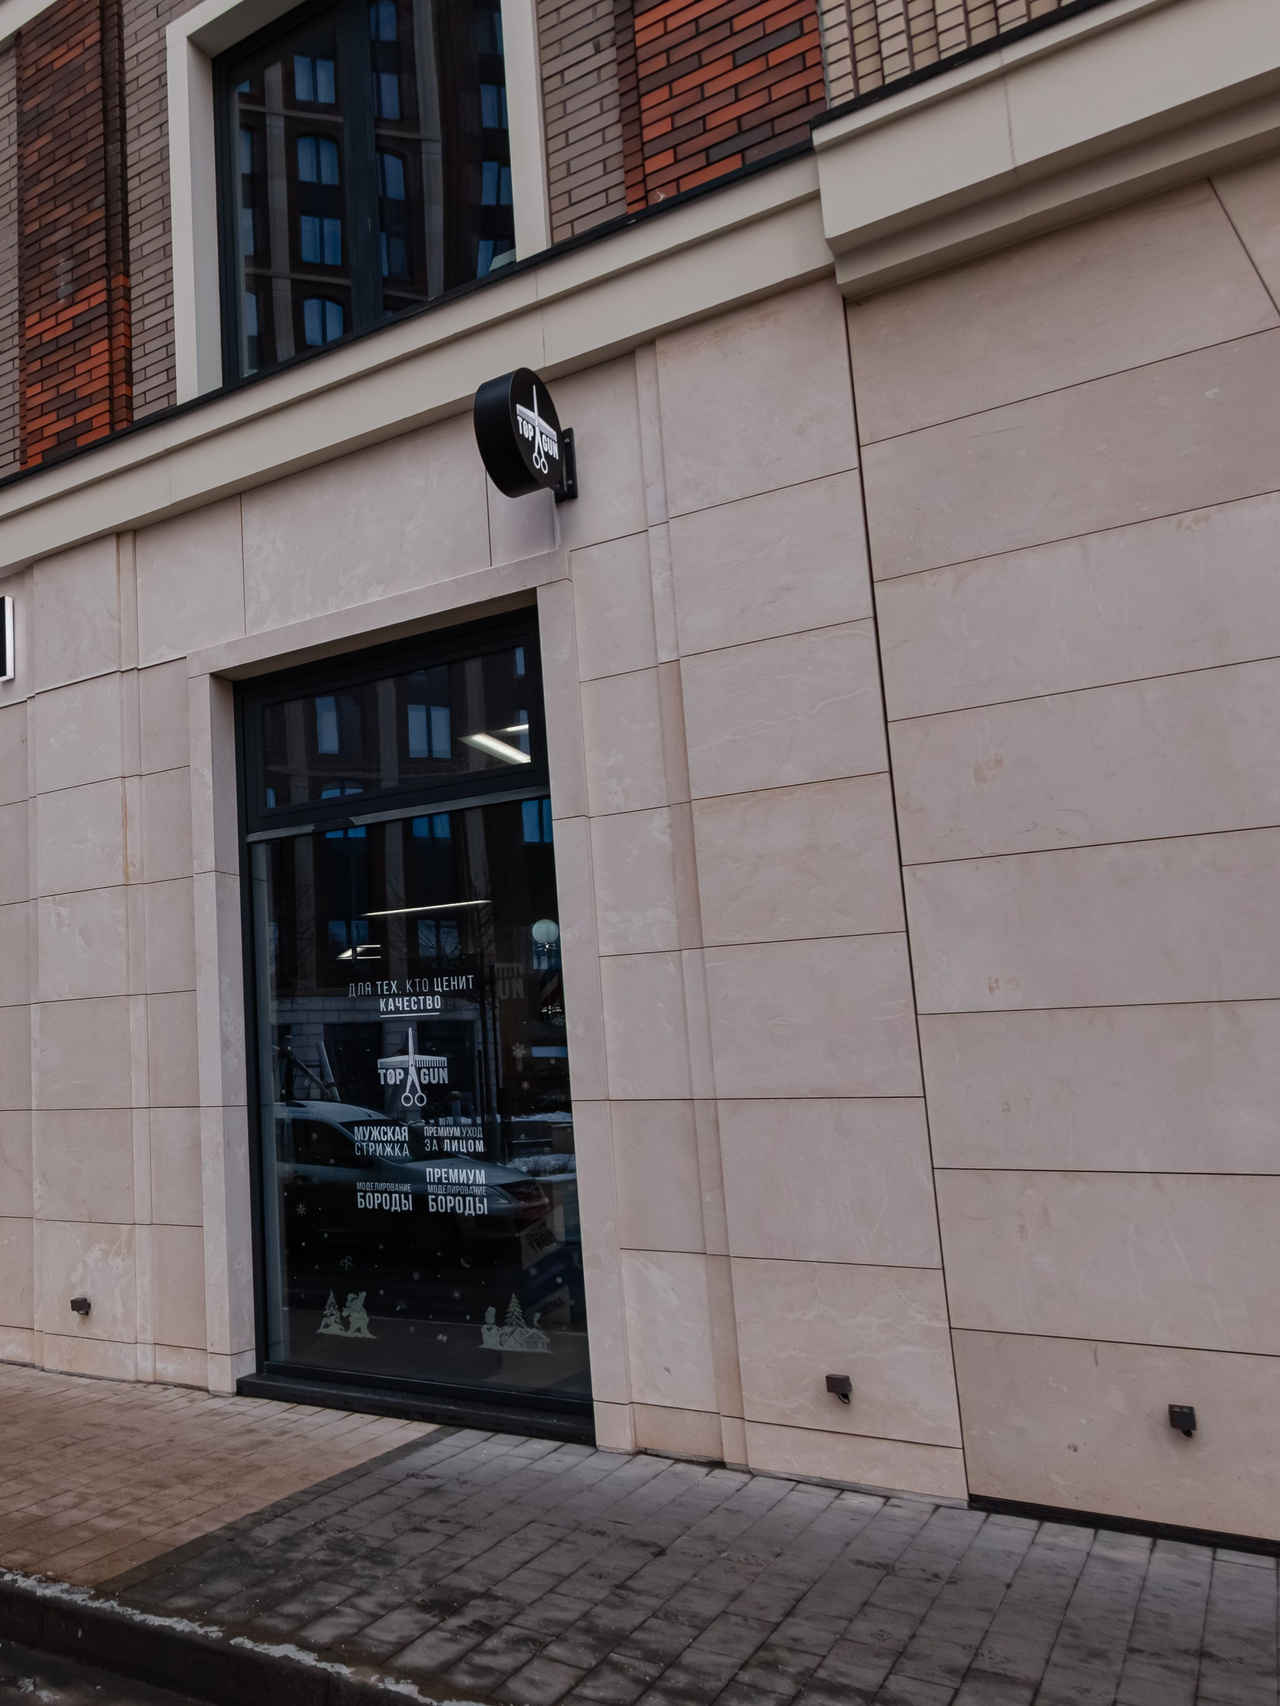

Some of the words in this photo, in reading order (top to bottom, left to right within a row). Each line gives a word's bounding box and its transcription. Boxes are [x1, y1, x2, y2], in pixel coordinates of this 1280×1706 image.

[517, 416, 534, 441] TOP
[542, 434, 559, 460] GUN
[348, 982, 372, 998] ДЛЯ
[406, 978, 429, 993] КТО
[434, 975, 474, 992] ЦЕНИТ
[380, 995, 442, 1012] КАЧЕСТВО
[377, 1069, 404, 1085] TOP
[420, 1068, 449, 1084] GUN
[354, 1126, 409, 1141] МУЖСКАЯ
[424, 1126, 460, 1137] ПРЕМИУМ
[461, 1126, 483, 1139] УХОД
[354, 1142, 410, 1156] СТРИЖКА
[425, 1139, 439, 1151] ЗА
[444, 1139, 485, 1153] ЛИЦОМ
[426, 1168, 486, 1184] ПРЕМИУМ
[356, 1182, 412, 1193] МОДЕЛИРОВАНИЕ
[427, 1184, 487, 1196] МОДЕЛИРОВАНИЕ
[356, 1192, 413, 1212] БОРОДЫ
[428, 1195, 488, 1216] БОРОДЫ
